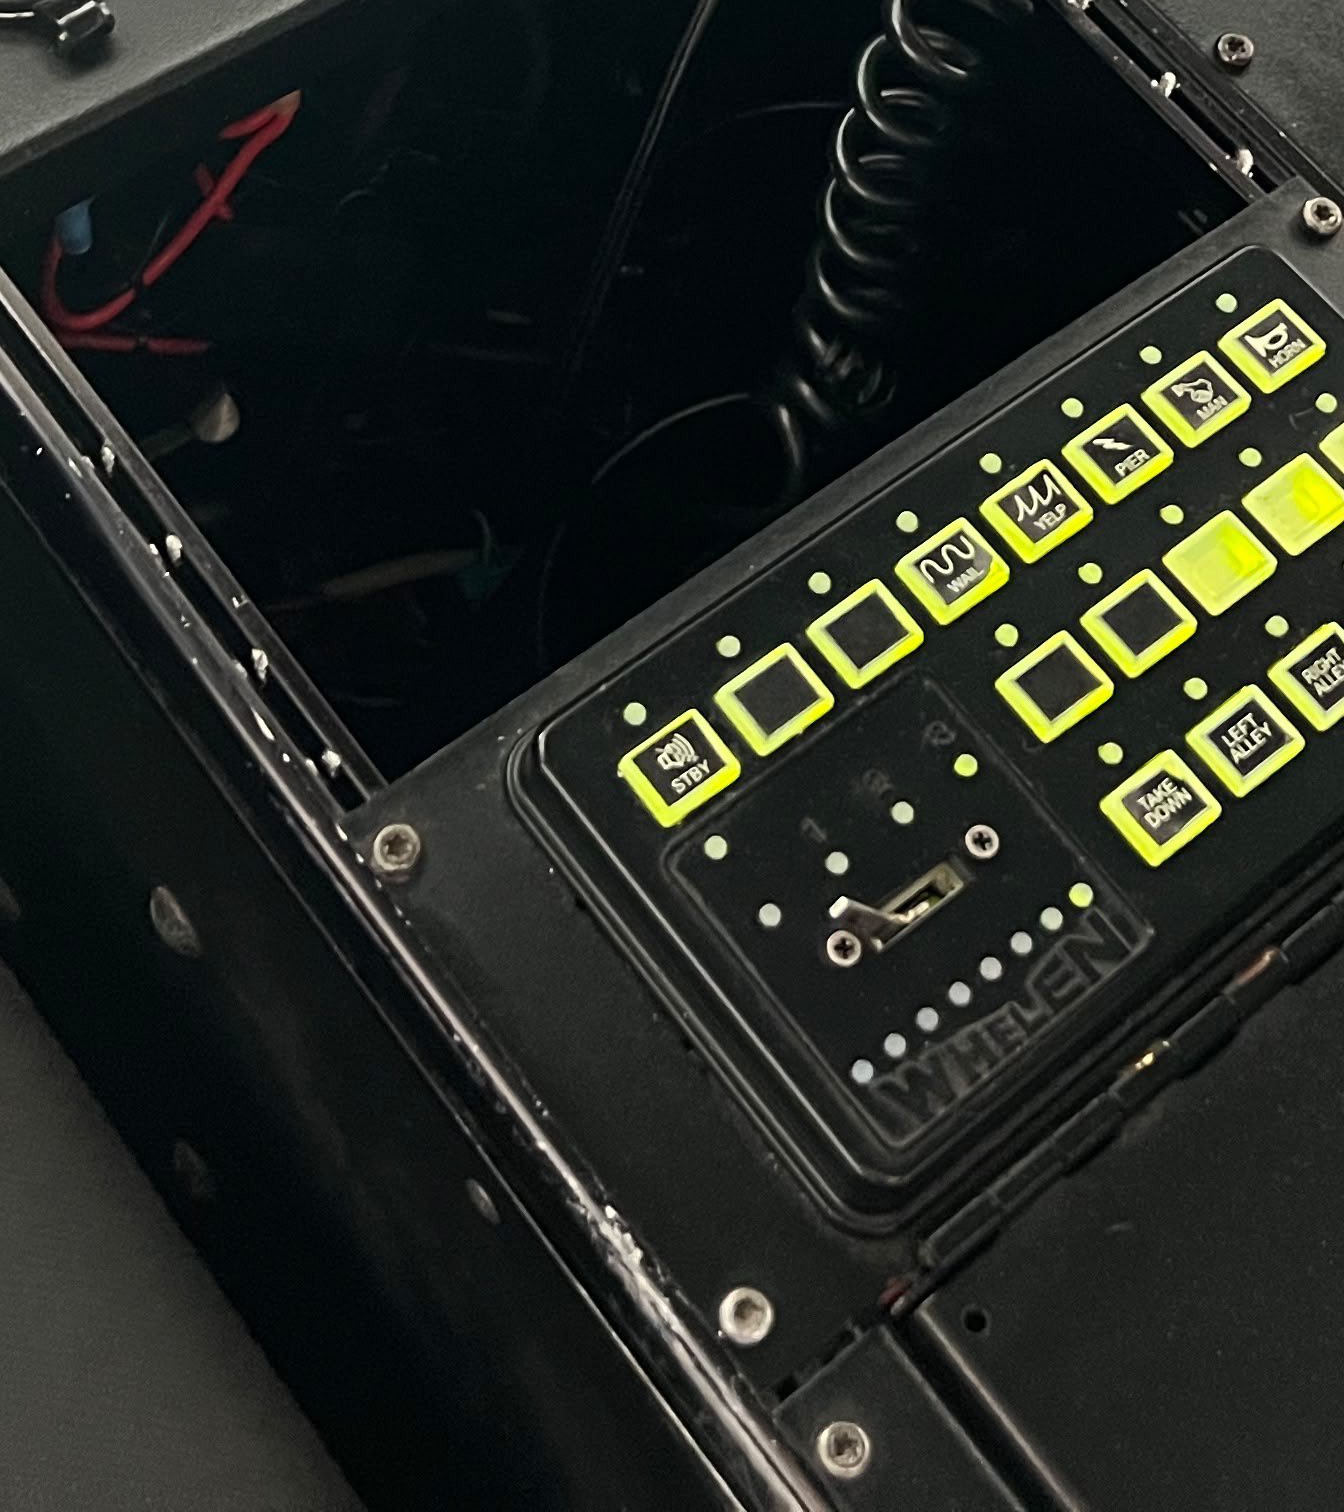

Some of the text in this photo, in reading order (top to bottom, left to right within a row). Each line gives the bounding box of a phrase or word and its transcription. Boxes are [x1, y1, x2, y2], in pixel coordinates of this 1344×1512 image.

[1267, 338, 1306, 368] HORN
[1196, 395, 1228, 421] MAN
[1114, 449, 1150, 477] PIER
[1033, 503, 1066, 530] YELP
[946, 567, 984, 593] WAIL
[1301, 647, 1341, 686] RIGHT
[1221, 712, 1257, 746] LEFT
[1229, 722, 1272, 764] ALLEY
[671, 759, 710, 794] STBY
[1136, 777, 1178, 811] TAKE
[1143, 787, 1193, 828] DOWN
[867, 904, 1137, 1128] WHELEN
